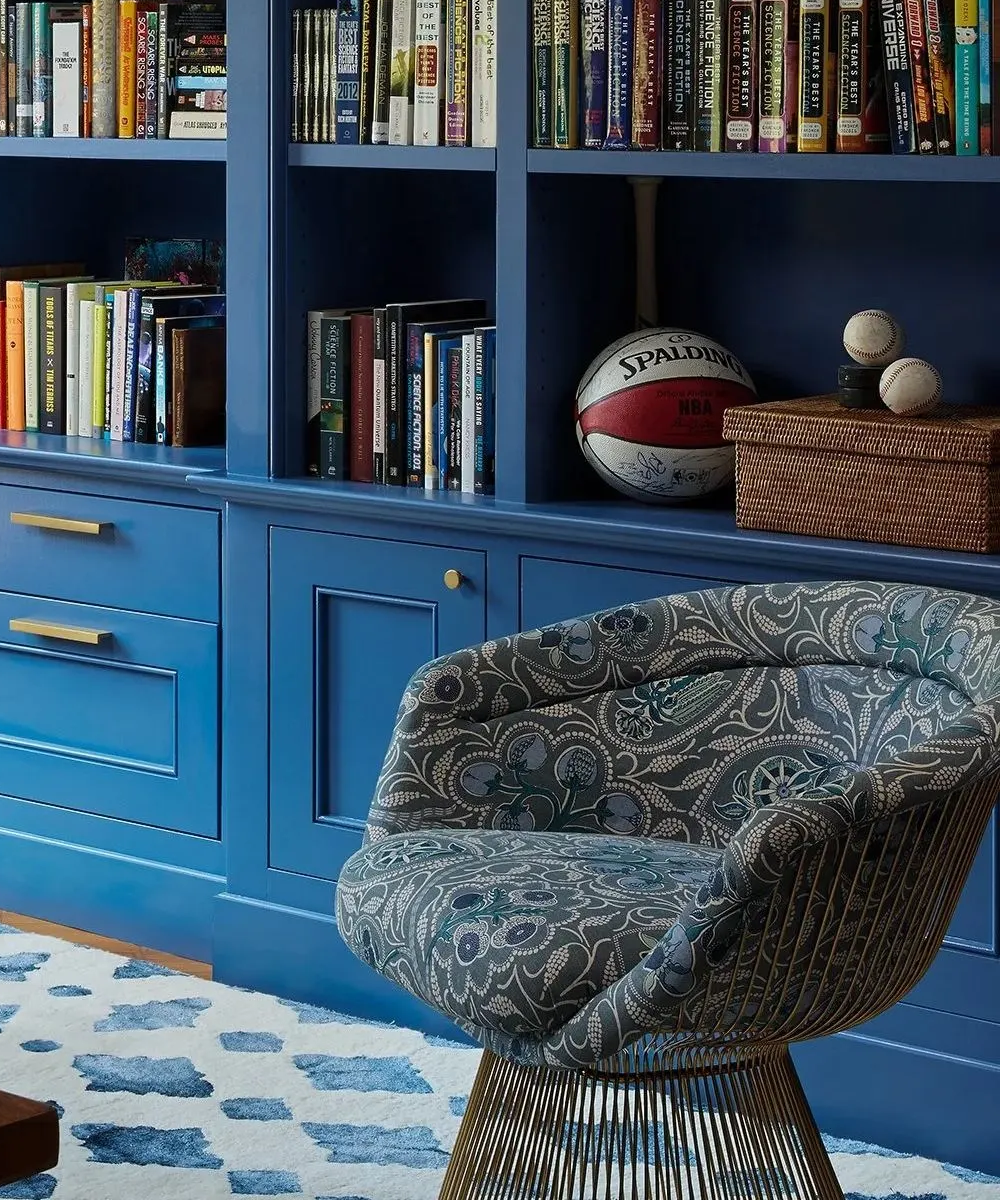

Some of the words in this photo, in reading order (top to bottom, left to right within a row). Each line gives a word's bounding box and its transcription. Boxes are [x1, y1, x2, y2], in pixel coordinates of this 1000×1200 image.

[380, 19, 388, 38] JOE
[731, 10, 741, 57] SCIENCE
[811, 22, 820, 40] THE
[907, 0, 920, 38] FORWARD
[137, 17, 145, 53] SOLARIS
[147, 29, 155, 66] SOLARIS
[897, 3, 908, 71] EXPANDING
[929, 35, 941, 43] 2
[137, 57, 145, 89] RISING
[379, 43, 387, 105] HALDEMAN
[454, 49, 463, 104] FICTION
[811, 45, 820, 78] YEAR'S
[147, 68, 155, 100] RISING
[338, 83, 358, 100] 2012
[676, 58, 684, 113] FICTION
[705, 56, 715, 109] FICTION
[731, 65, 741, 112] FICTION
[811, 83, 820, 109] BEST
[46, 297, 54, 319] TOOLS
[46, 320, 54, 329] OF
[46, 331, 54, 355] TITANS
[475, 335, 483, 354] WHAT
[46, 369, 54, 382] TIM
[475, 355, 483, 375] EVERY
[618, 345, 743, 381] SPALDING
[46, 383, 54, 413] FERRISS
[413, 374, 422, 412] SCIENCE
[475, 376, 483, 392] BODY
[475, 402, 483, 426] SAYING
[678, 400, 712, 416] NBA
[413, 413, 422, 451] FICTION:
[413, 454, 422, 470] 101
